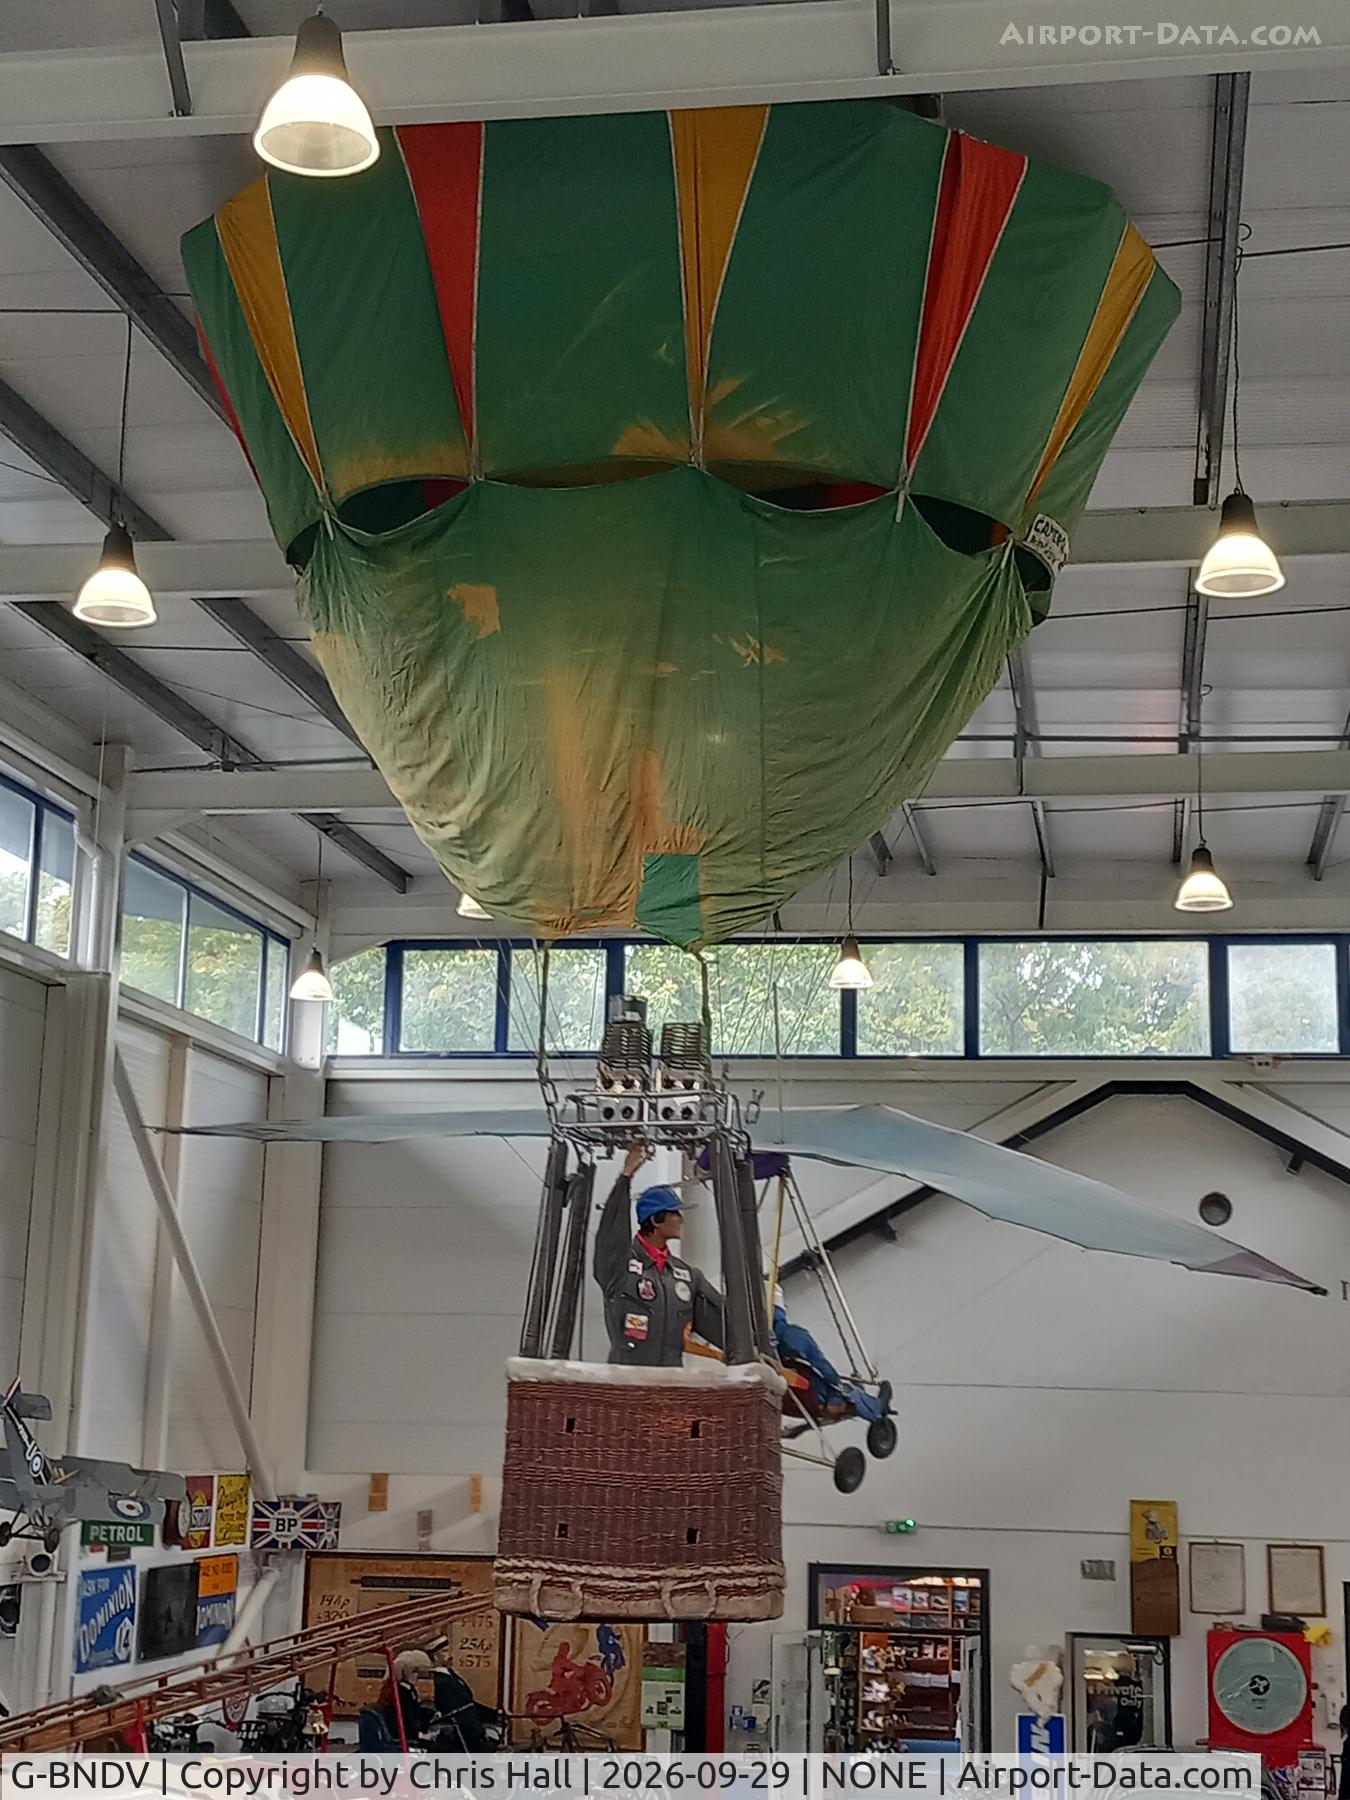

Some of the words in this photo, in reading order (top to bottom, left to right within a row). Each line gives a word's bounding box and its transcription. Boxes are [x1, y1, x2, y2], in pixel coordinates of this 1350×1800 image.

[89, 1524, 145, 1542] PETROL
[275, 1517, 298, 1533] BP
[79, 1568, 135, 1664] DOMINION
[1095, 1681, 1143, 1696] Private
[1120, 1696, 1142, 1709] Only
